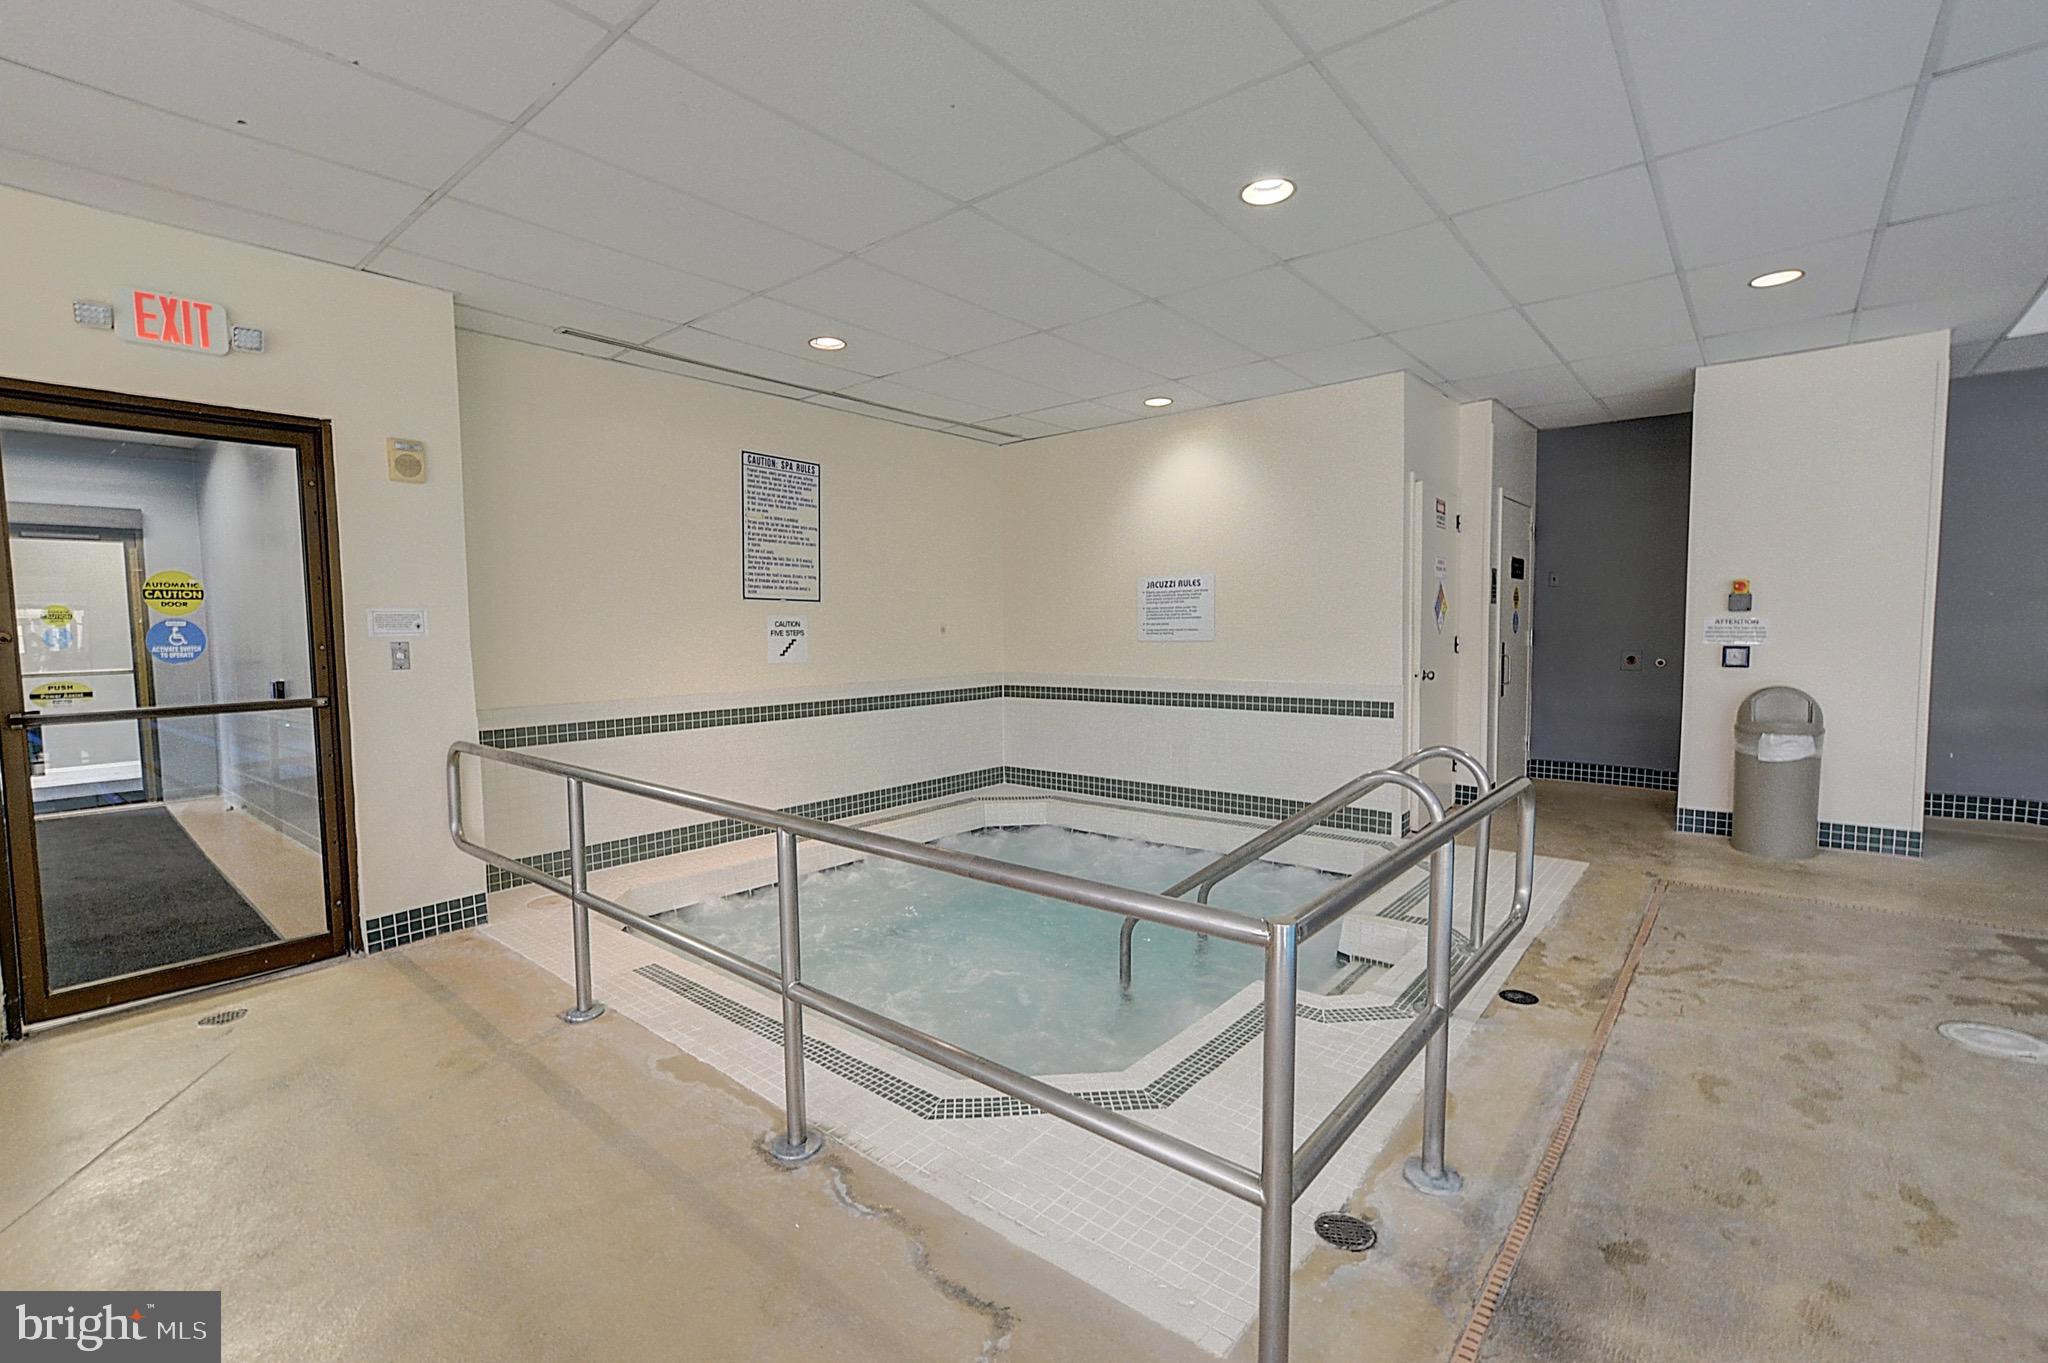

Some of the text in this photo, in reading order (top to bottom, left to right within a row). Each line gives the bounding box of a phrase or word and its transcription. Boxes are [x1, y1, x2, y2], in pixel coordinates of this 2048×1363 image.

[133, 290, 213, 350] EXIT
[747, 454, 816, 475] CAUTION: SPA RULES
[1146, 578, 1201, 589] JACUZZI RULES
[144, 590, 202, 599] CAUTION
